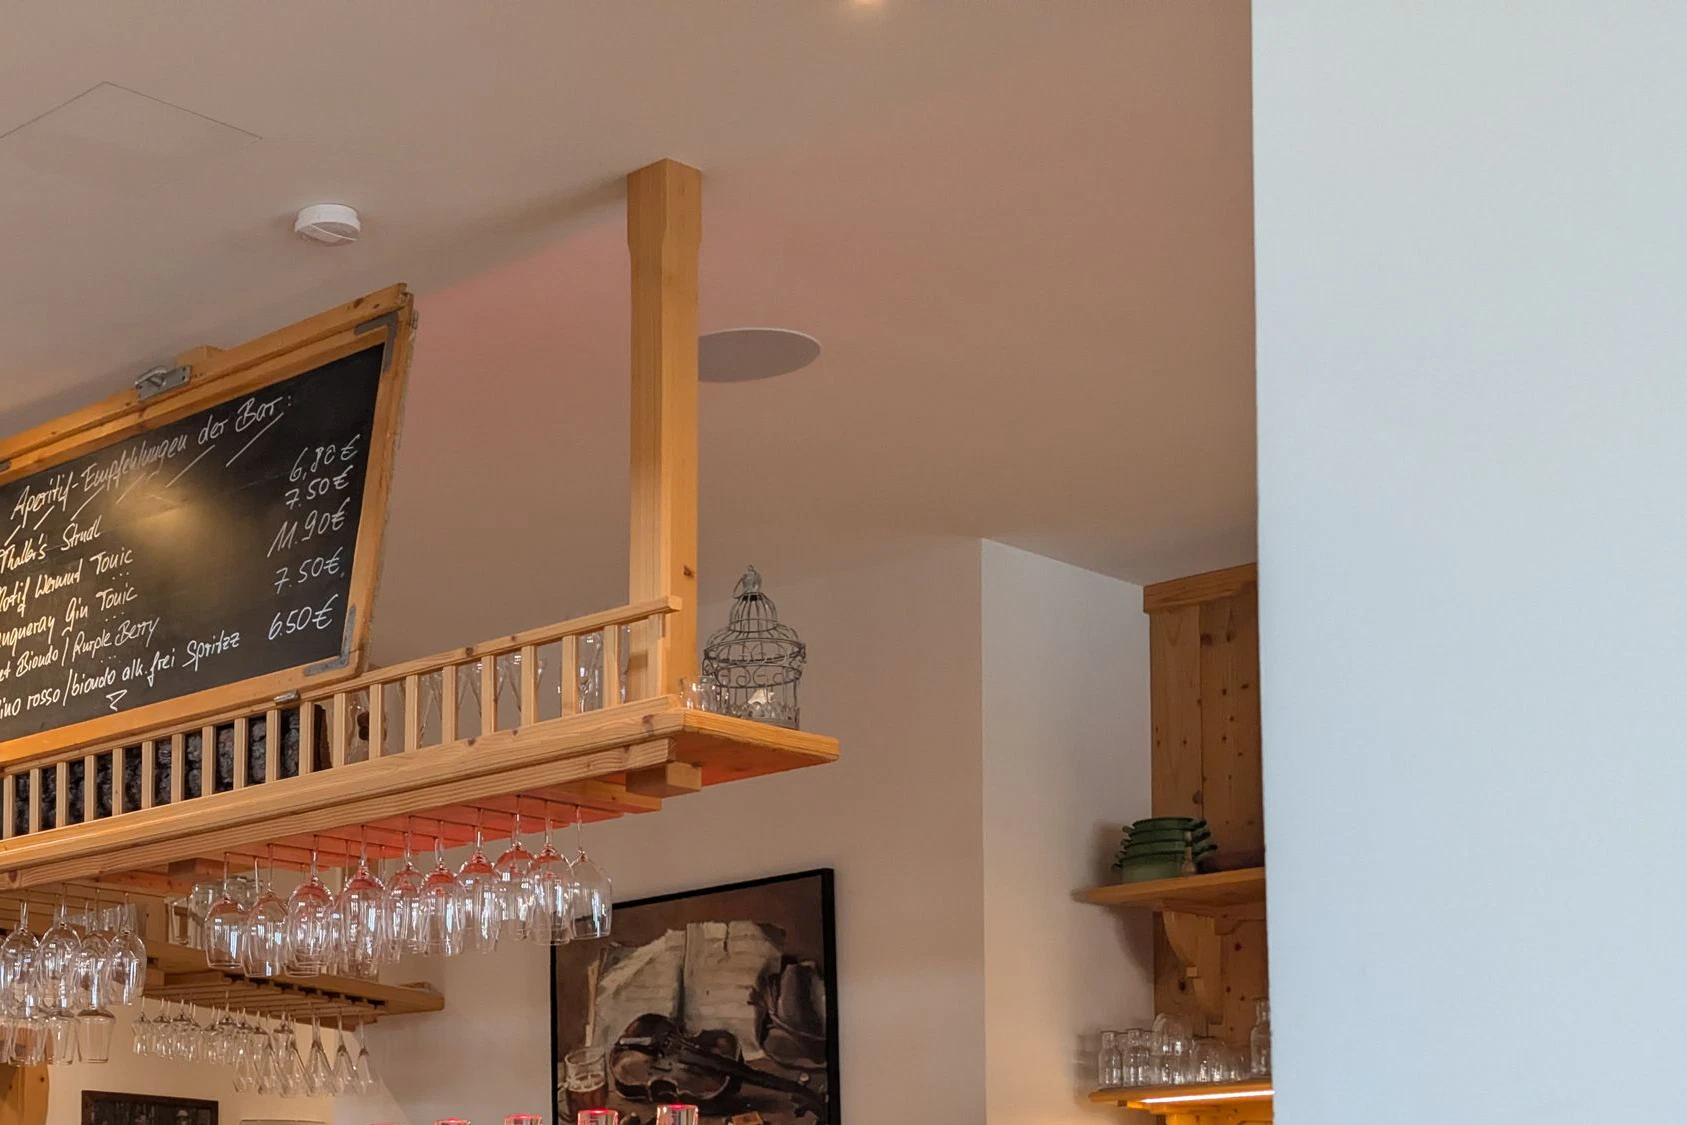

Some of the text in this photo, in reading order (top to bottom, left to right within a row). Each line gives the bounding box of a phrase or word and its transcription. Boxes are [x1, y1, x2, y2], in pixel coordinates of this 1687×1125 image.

[198, 414, 229, 445] der
[89, 547, 134, 575] Tonic
[61, 597, 88, 637] Gin
[95, 582, 138, 611] Tonic
[268, 593, 339, 640] 6.50€
[114, 617, 160, 648] Berry
